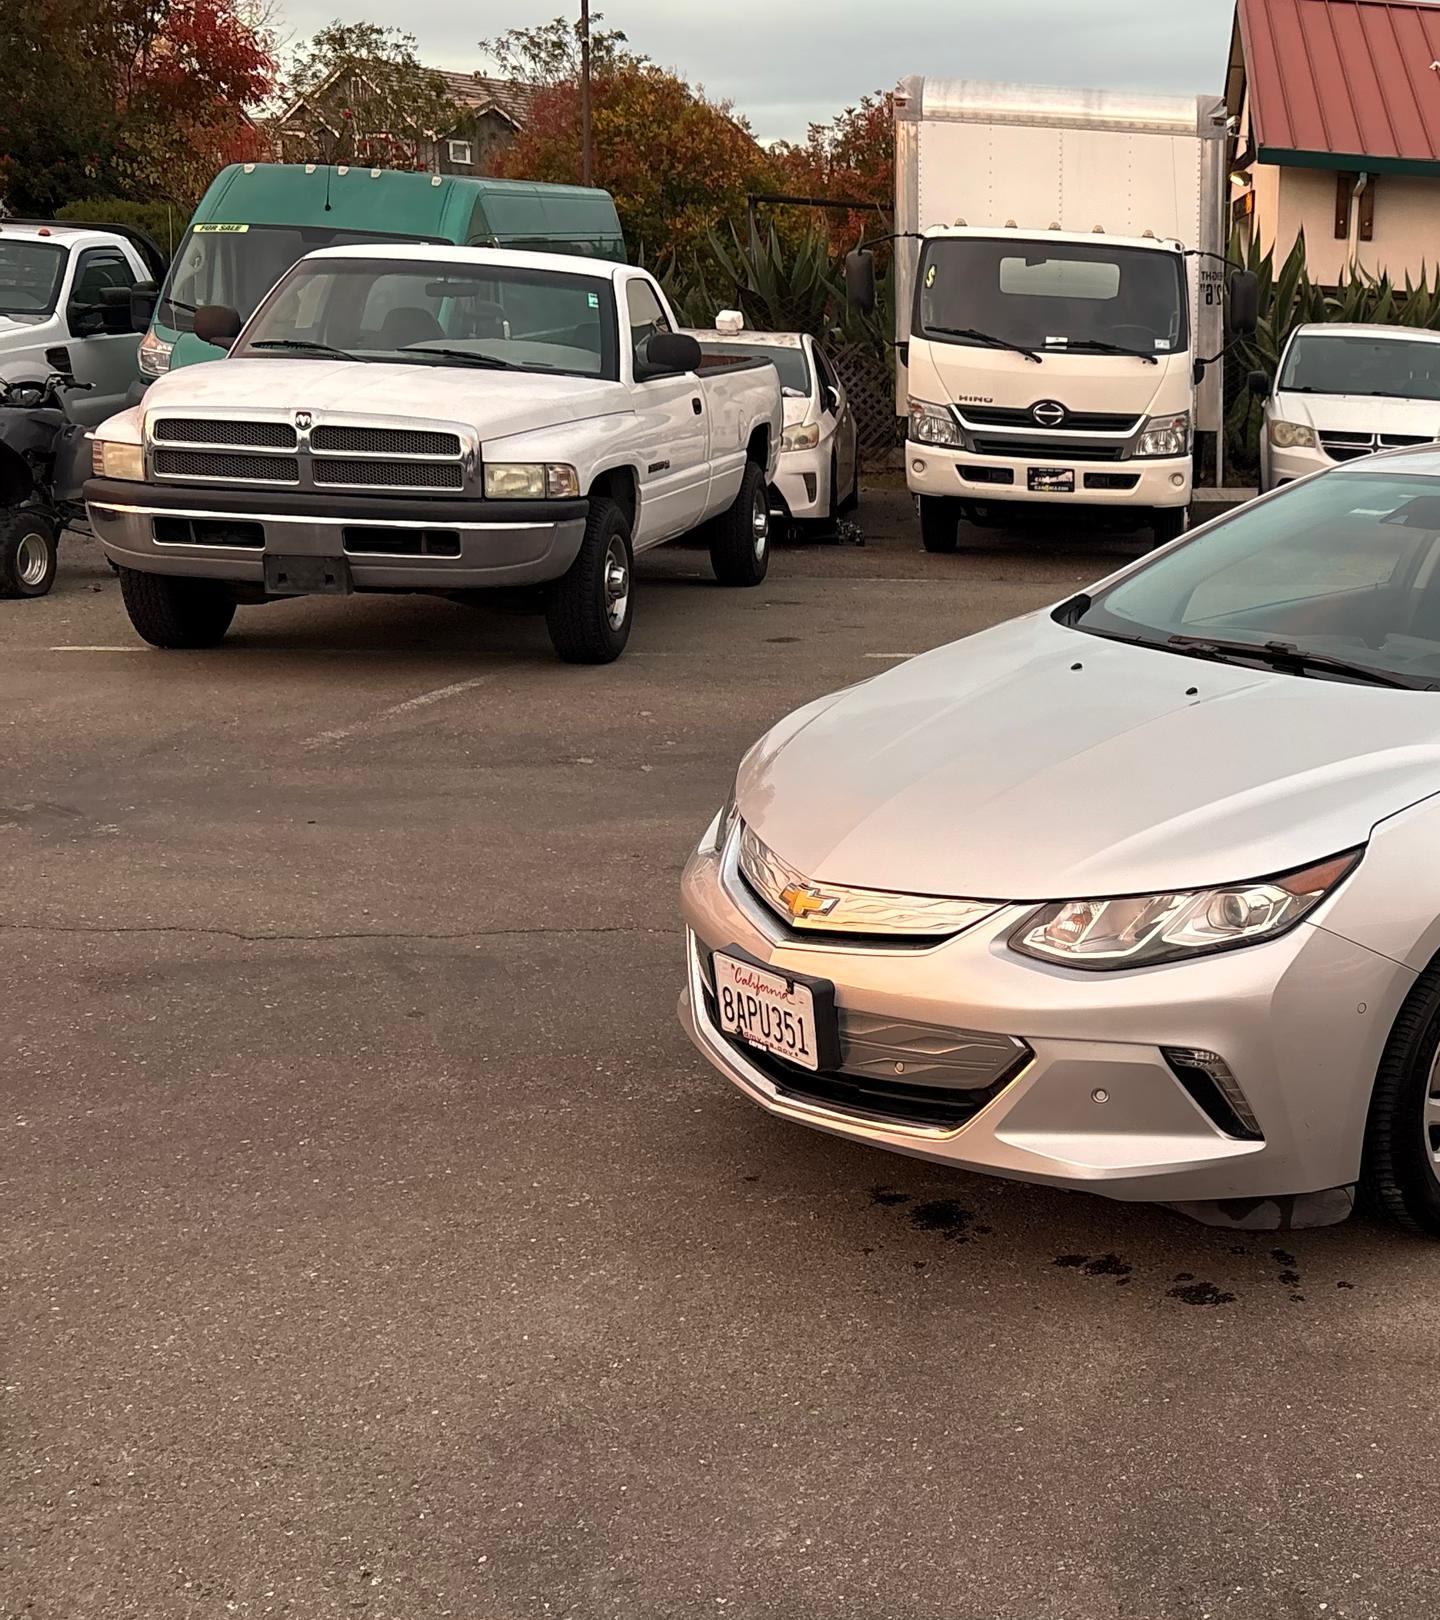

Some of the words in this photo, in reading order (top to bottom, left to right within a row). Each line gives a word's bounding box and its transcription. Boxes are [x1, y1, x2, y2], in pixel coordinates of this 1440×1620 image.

[958, 394, 994, 403] HINO
[734, 967, 789, 1001] California
[723, 986, 809, 1056] 8APU351
